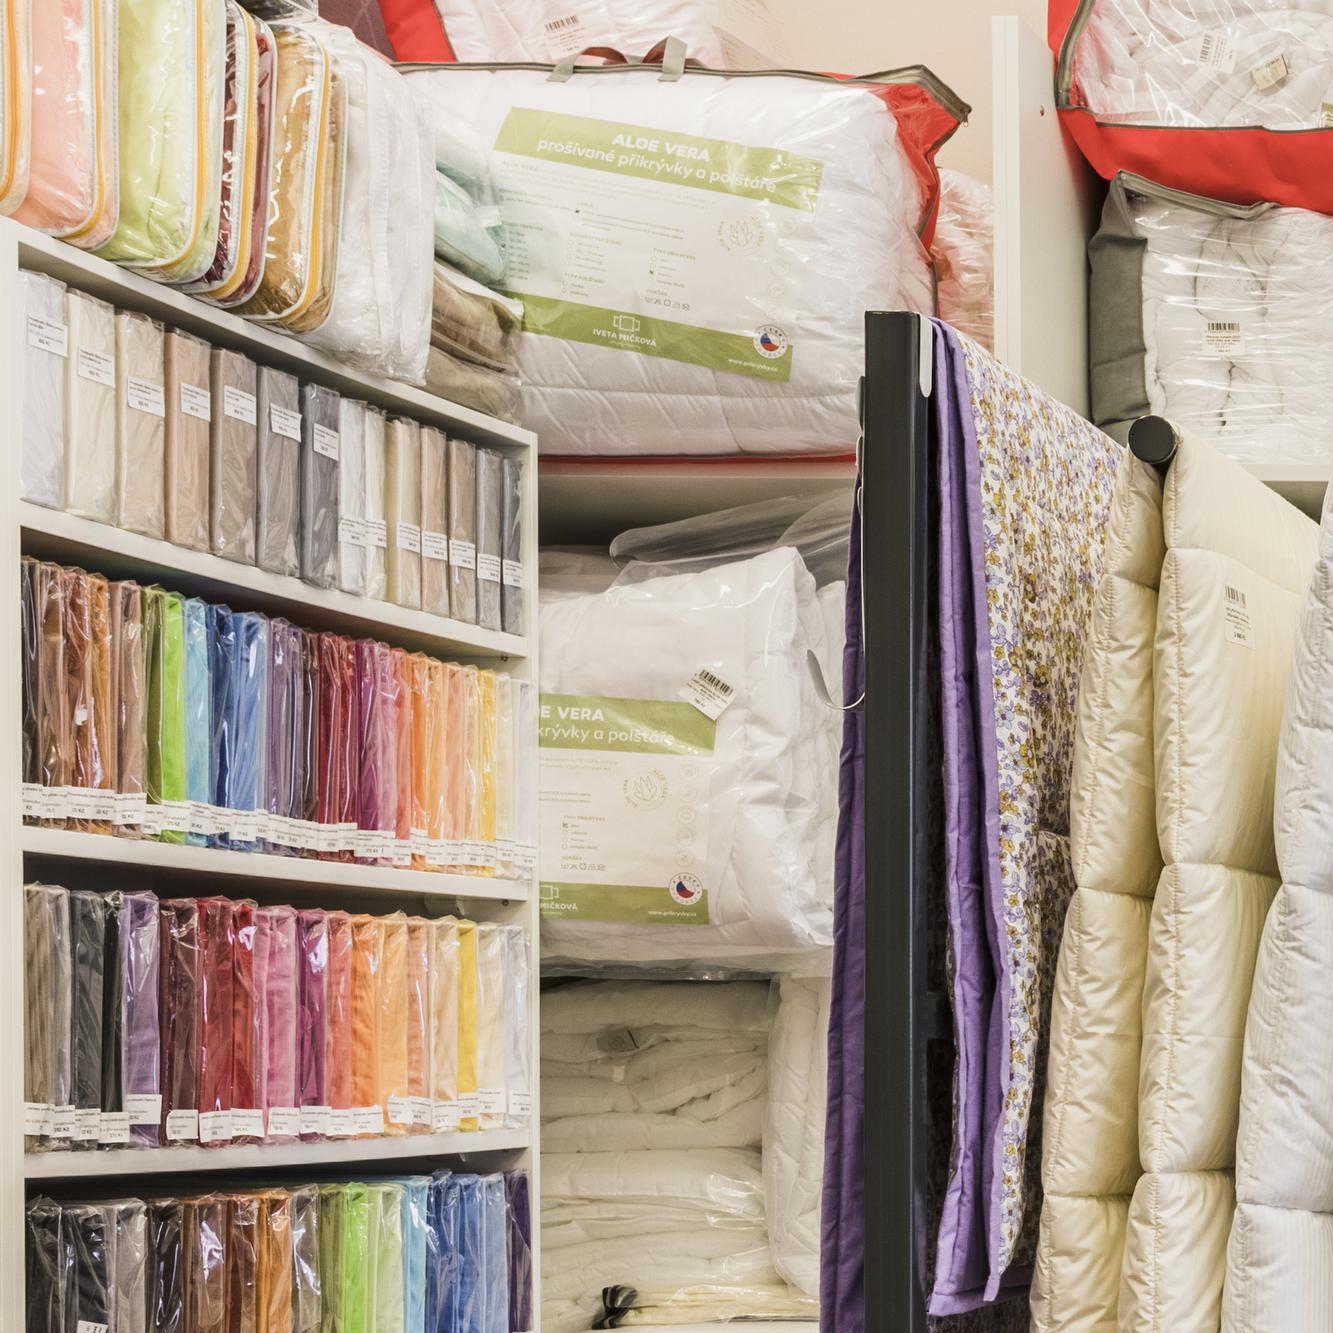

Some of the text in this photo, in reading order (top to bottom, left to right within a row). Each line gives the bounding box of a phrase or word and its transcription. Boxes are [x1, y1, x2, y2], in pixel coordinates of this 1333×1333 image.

[611, 133, 711, 162] ALOE VERA
[537, 137, 616, 163] prošívané
[618, 152, 693, 180] přikrývky
[696, 169, 706, 181] a
[708, 170, 777, 194] polštáře
[592, 328, 657, 347] IVETA MIČKOVÁ
[557, 706, 605, 722] VERA
[594, 729, 604, 740] a
[608, 728, 676, 747] polštáře
[539, 899, 578, 911] MIČKOVÁ
